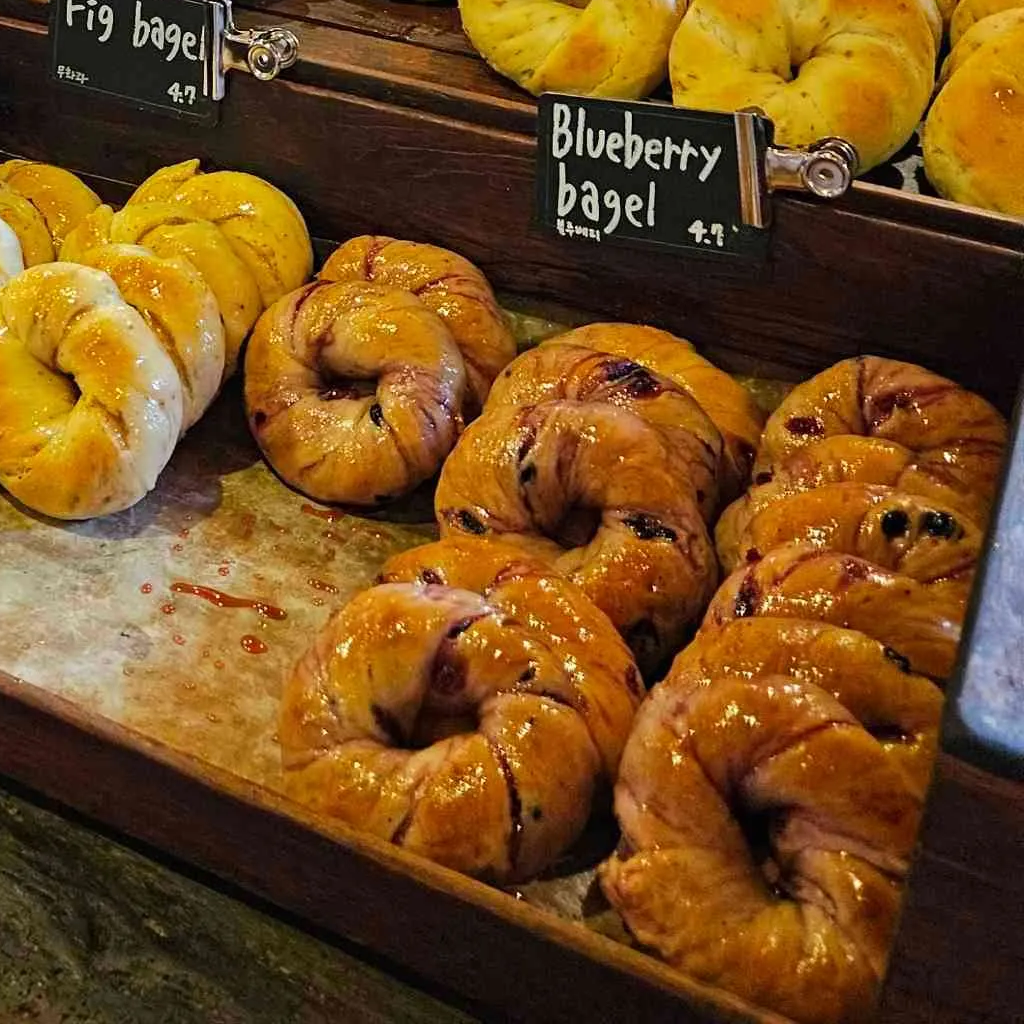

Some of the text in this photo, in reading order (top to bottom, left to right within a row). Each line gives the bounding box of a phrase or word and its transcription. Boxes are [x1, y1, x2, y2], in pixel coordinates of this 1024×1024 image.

[132, 0, 205, 62] bagel
[57, 65, 89, 84] 무화과
[167, 82, 197, 105] 4.7
[552, 103, 721, 182] Blueberry
[557, 162, 655, 234] bagel
